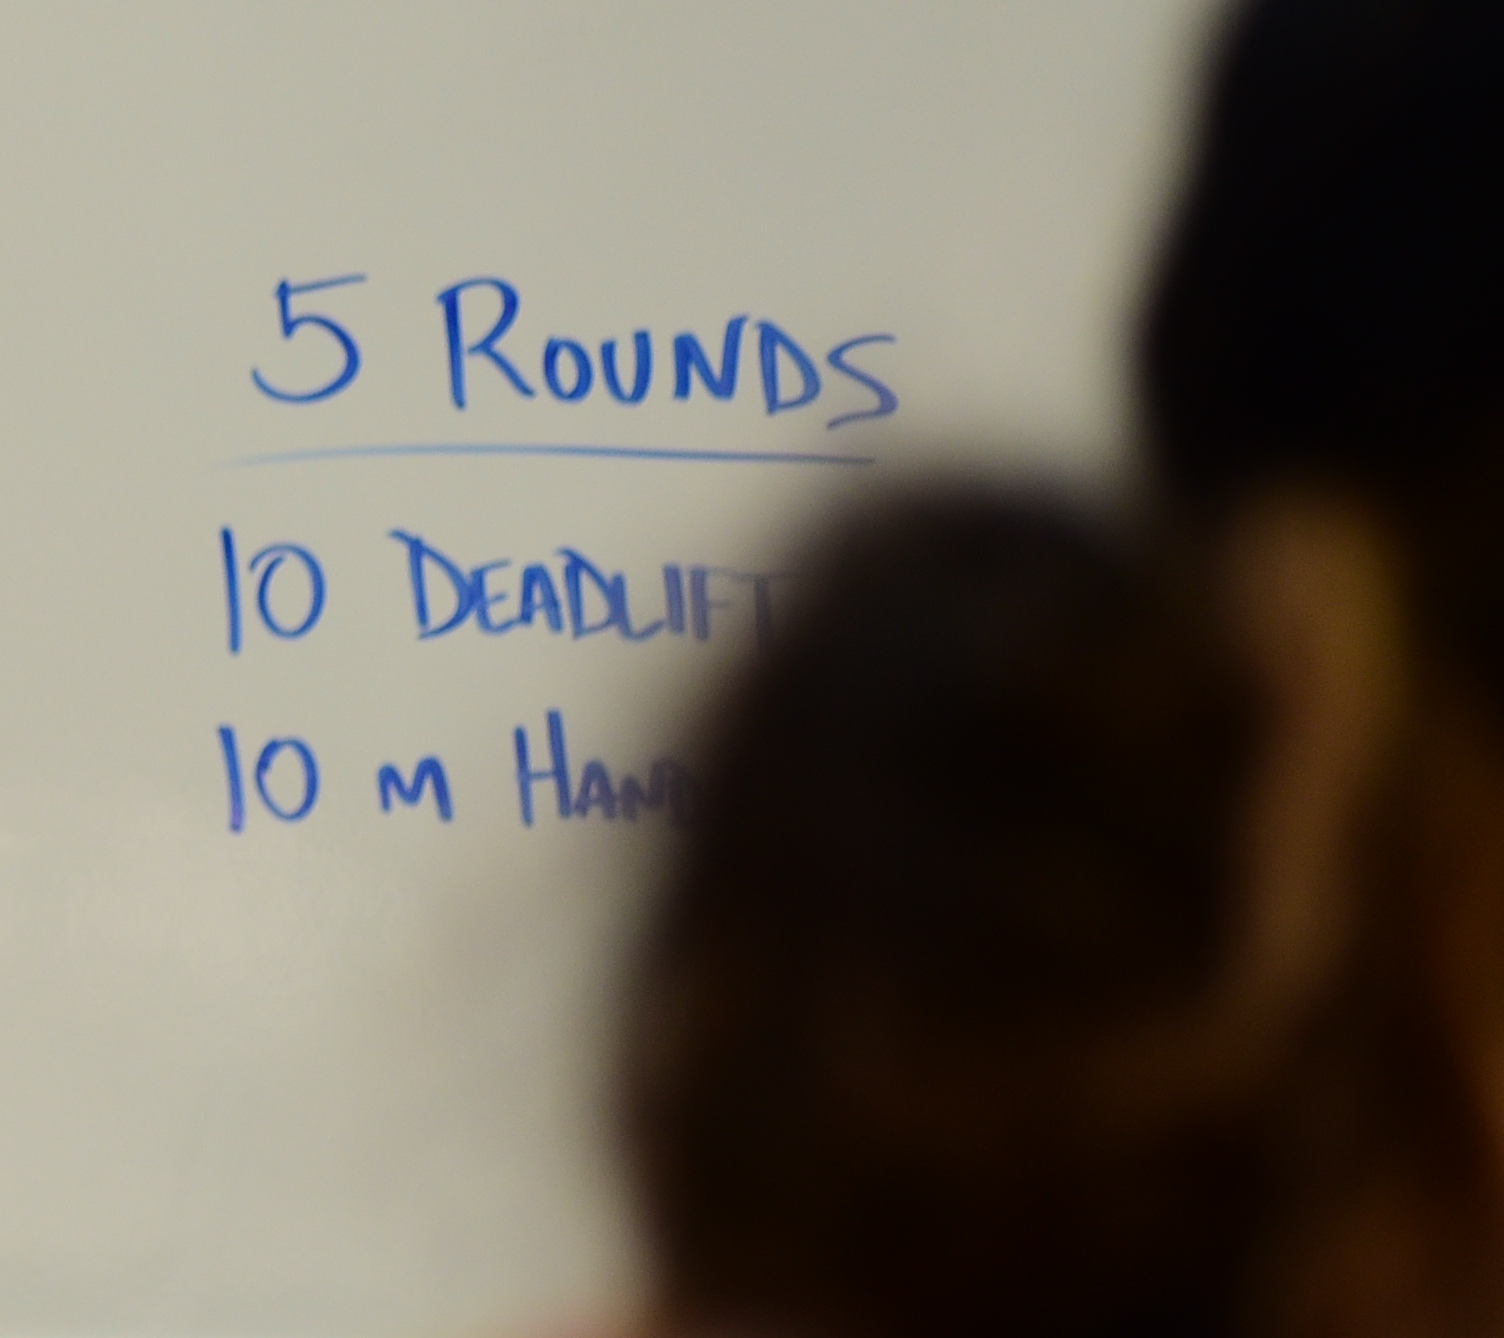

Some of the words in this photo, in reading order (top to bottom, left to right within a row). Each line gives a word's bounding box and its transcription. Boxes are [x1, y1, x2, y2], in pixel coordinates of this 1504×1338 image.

[252, 274, 365, 405] 5
[436, 276, 899, 429] ROUNDS
[220, 525, 329, 655] 10
[218, 724, 322, 834] 10
